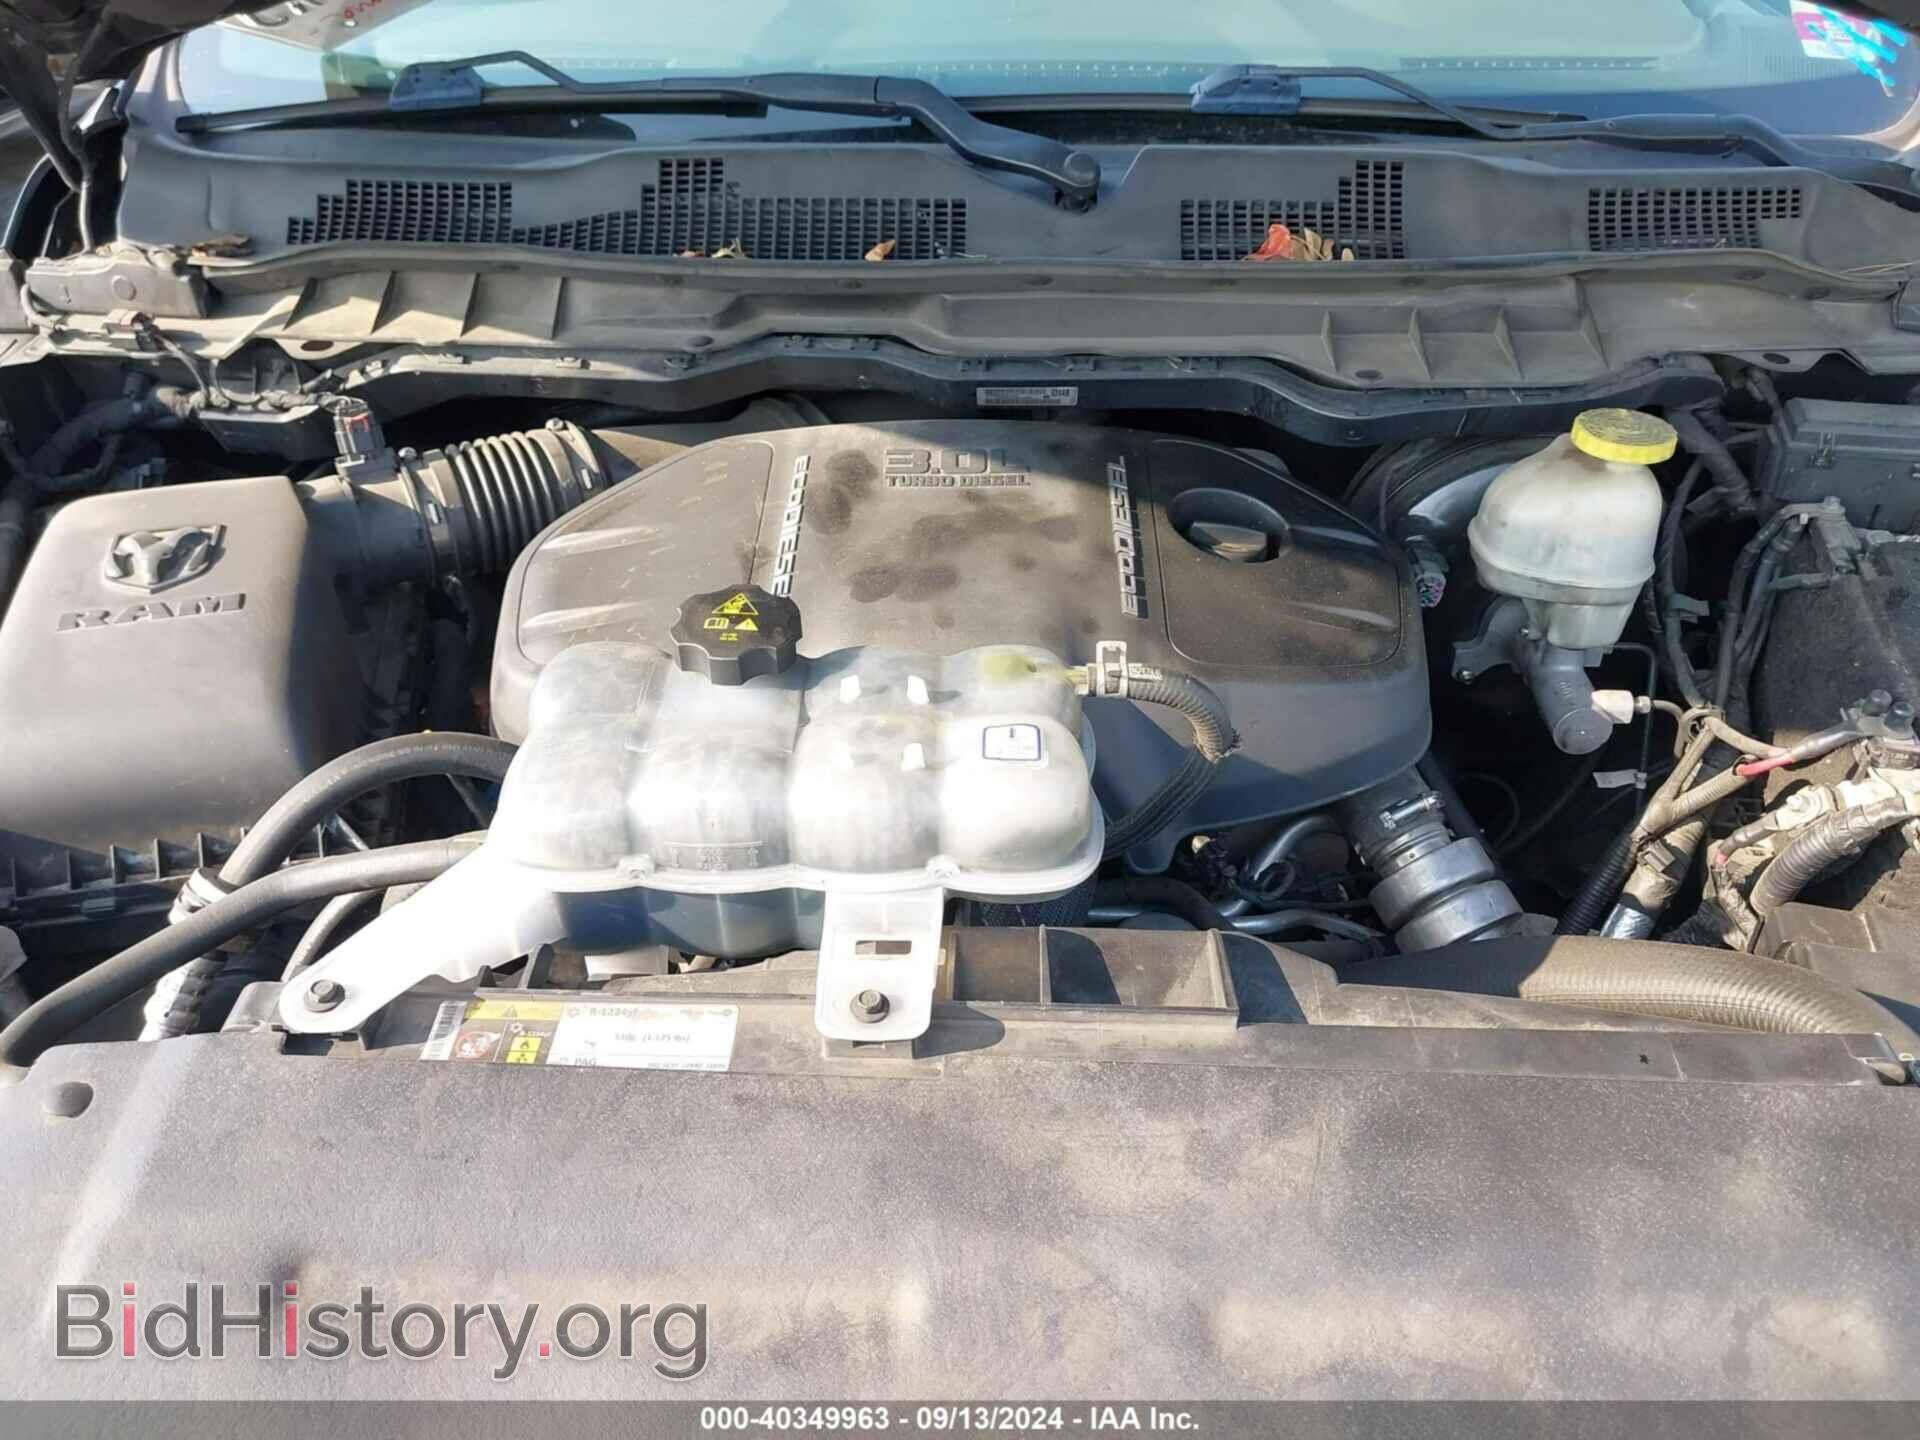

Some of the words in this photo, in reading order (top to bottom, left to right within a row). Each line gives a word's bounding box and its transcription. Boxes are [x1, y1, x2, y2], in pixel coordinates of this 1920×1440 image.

[885, 448, 1032, 474] 3.0L
[886, 475, 956, 488] TURBO
[959, 475, 1032, 488] DIESEL
[771, 455, 811, 598] ECODIESE
[1107, 455, 1139, 617] ECODIESEL
[57, 593, 247, 632] RAM
